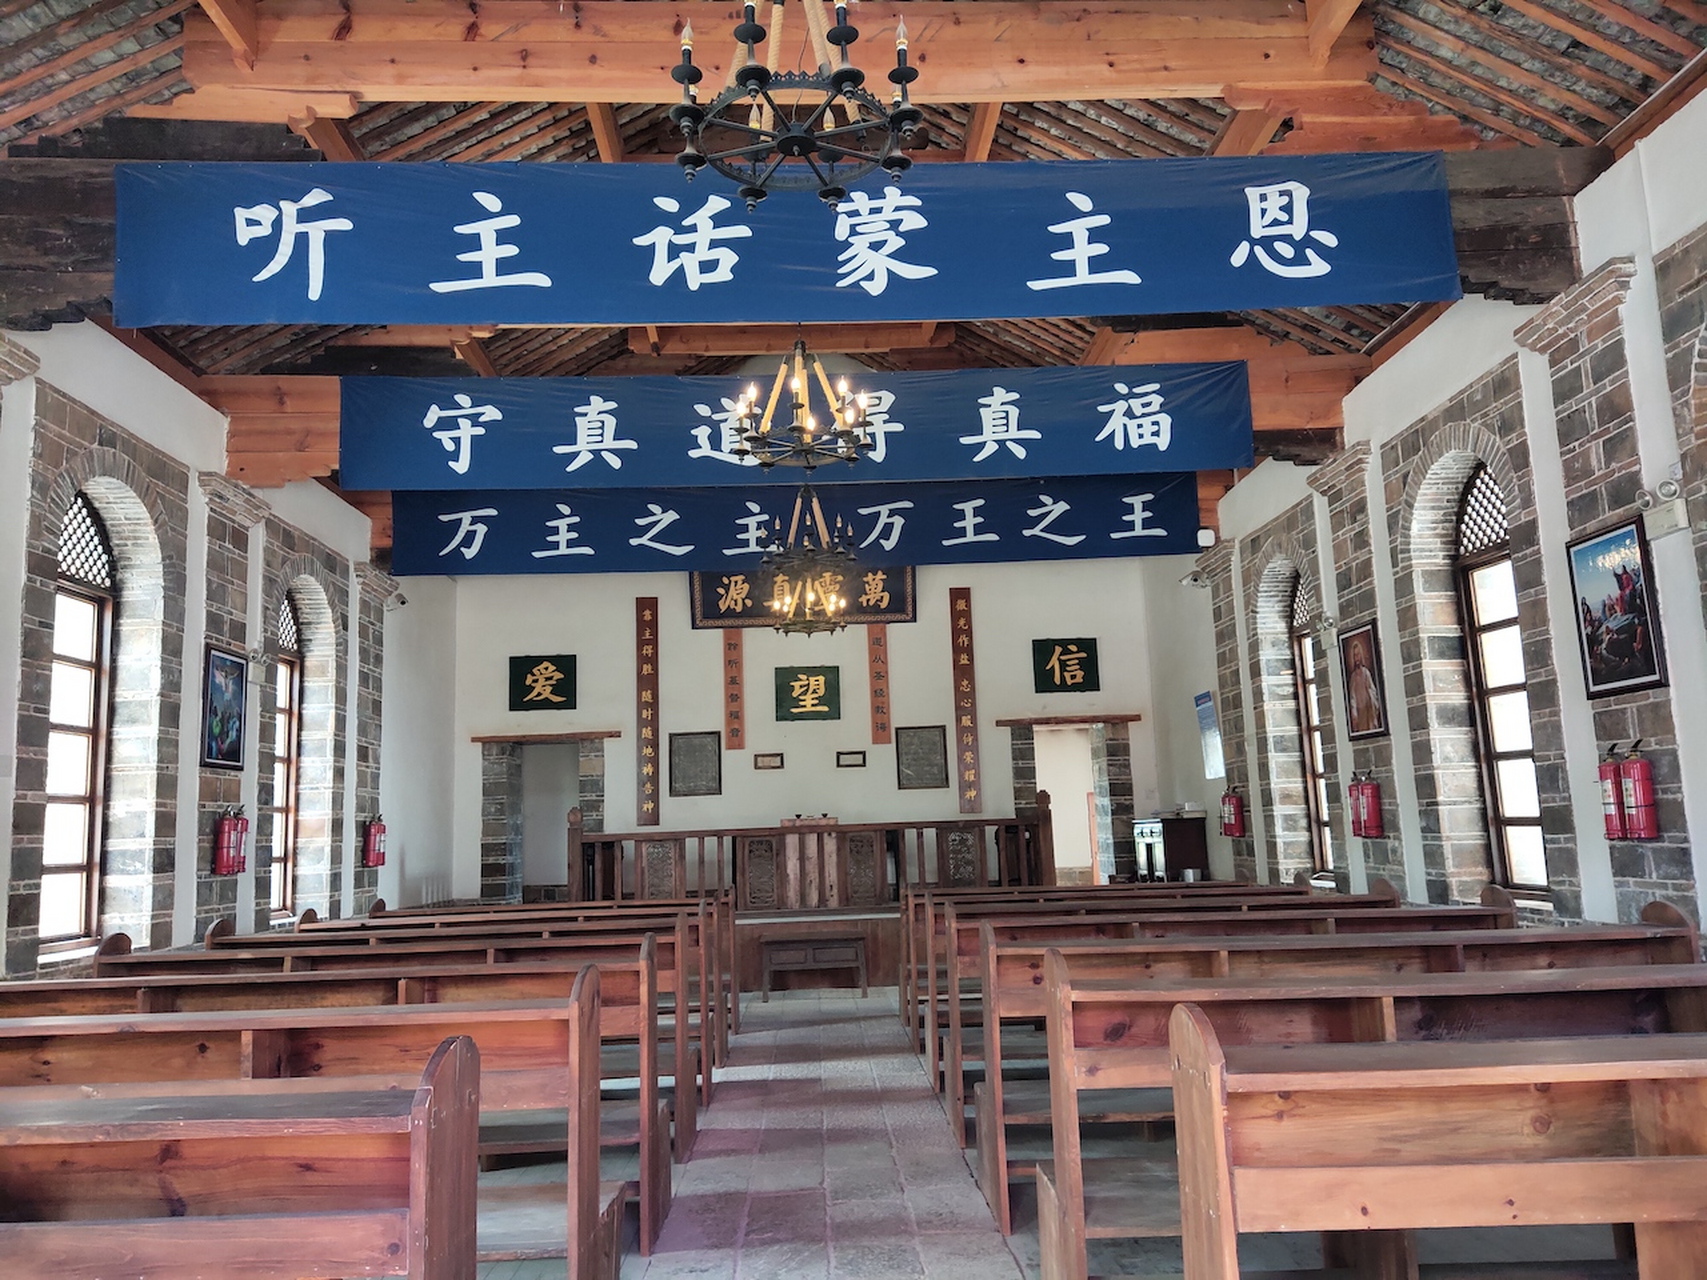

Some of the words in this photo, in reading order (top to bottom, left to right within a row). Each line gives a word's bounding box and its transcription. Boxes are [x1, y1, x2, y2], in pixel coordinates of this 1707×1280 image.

[234, 180, 1339, 301] 听主话蒙主恩
[423, 382, 1172, 475] 守真道得真福
[438, 493, 1169, 560] 万主之主万王之王
[522, 660, 567, 703] 爱
[1045, 643, 1088, 686] 信
[789, 674, 830, 714] 望
